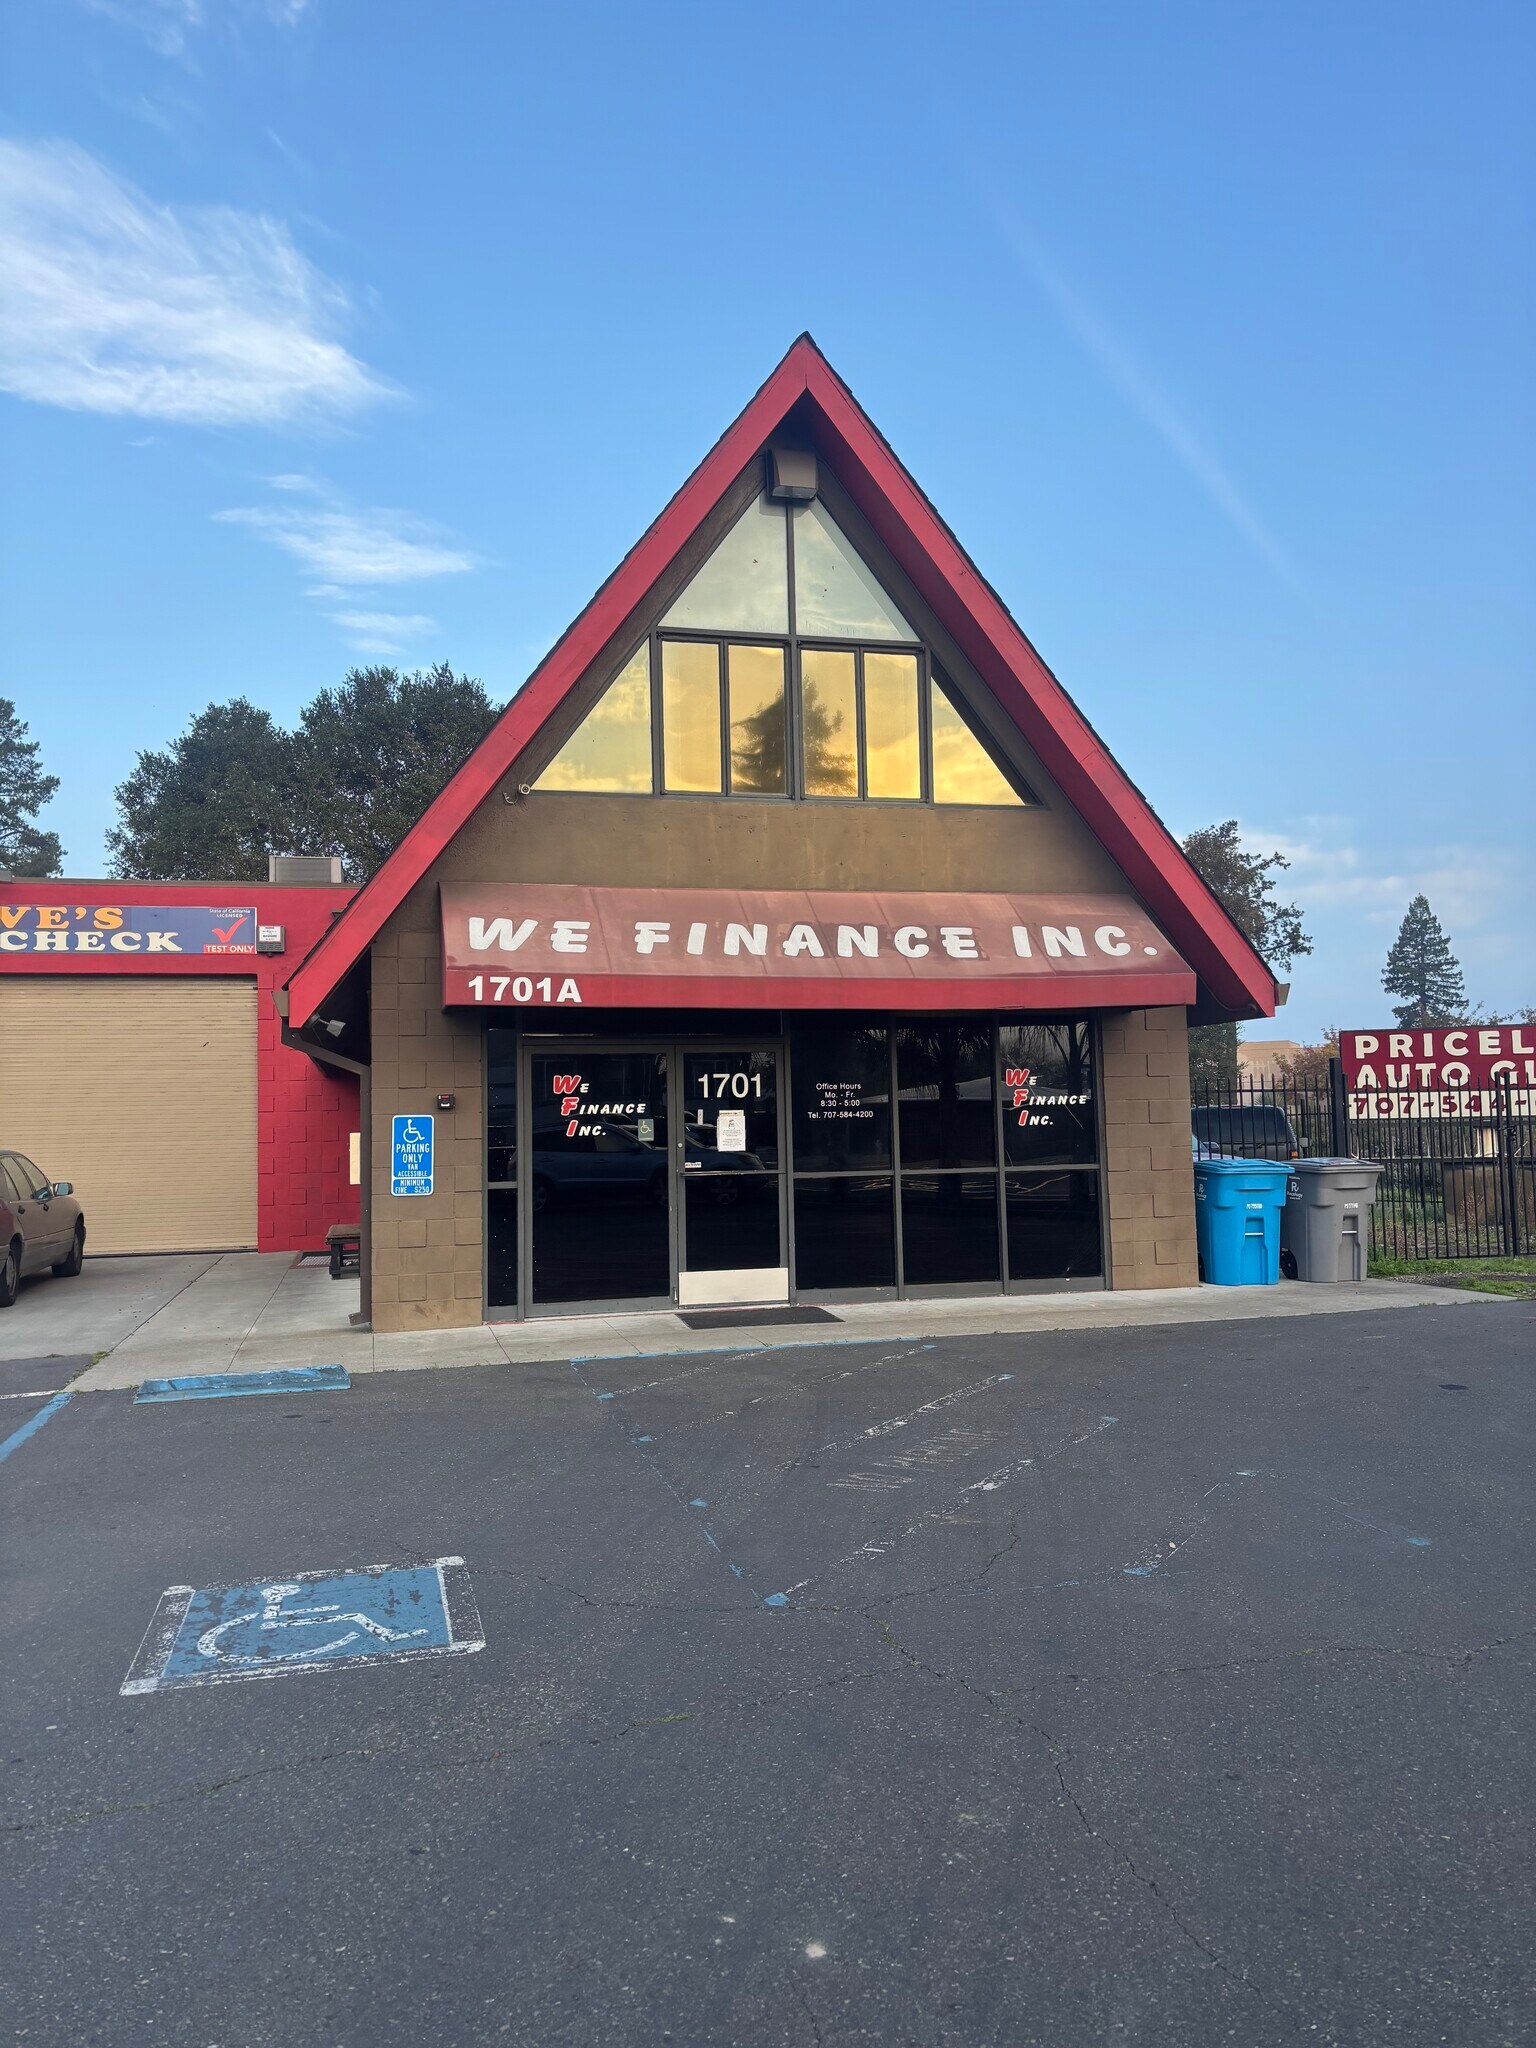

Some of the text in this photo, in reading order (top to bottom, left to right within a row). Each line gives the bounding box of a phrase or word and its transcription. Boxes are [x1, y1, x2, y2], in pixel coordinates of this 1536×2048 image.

[0, 906, 124, 930] VE'S
[0, 930, 183, 951] CHECK
[468, 917, 1158, 959] WE FINANCE INC.
[206, 945, 254, 953] TEST ONLY
[467, 975, 583, 1004] 1701A
[1354, 1029, 1535, 1059] PRICEL
[698, 1072, 761, 1098] 1701
[1353, 1061, 1471, 1089] AUTO
[807, 1110, 874, 1119] Tel. 707-584-4200
[1353, 1093, 1536, 1115] 707-544-
[395, 1143, 430, 1153] PARKING
[402, 1153, 423, 1163] ONLY
[400, 1179, 425, 1187] MINIMUM
[414, 1186, 430, 1194] $250
